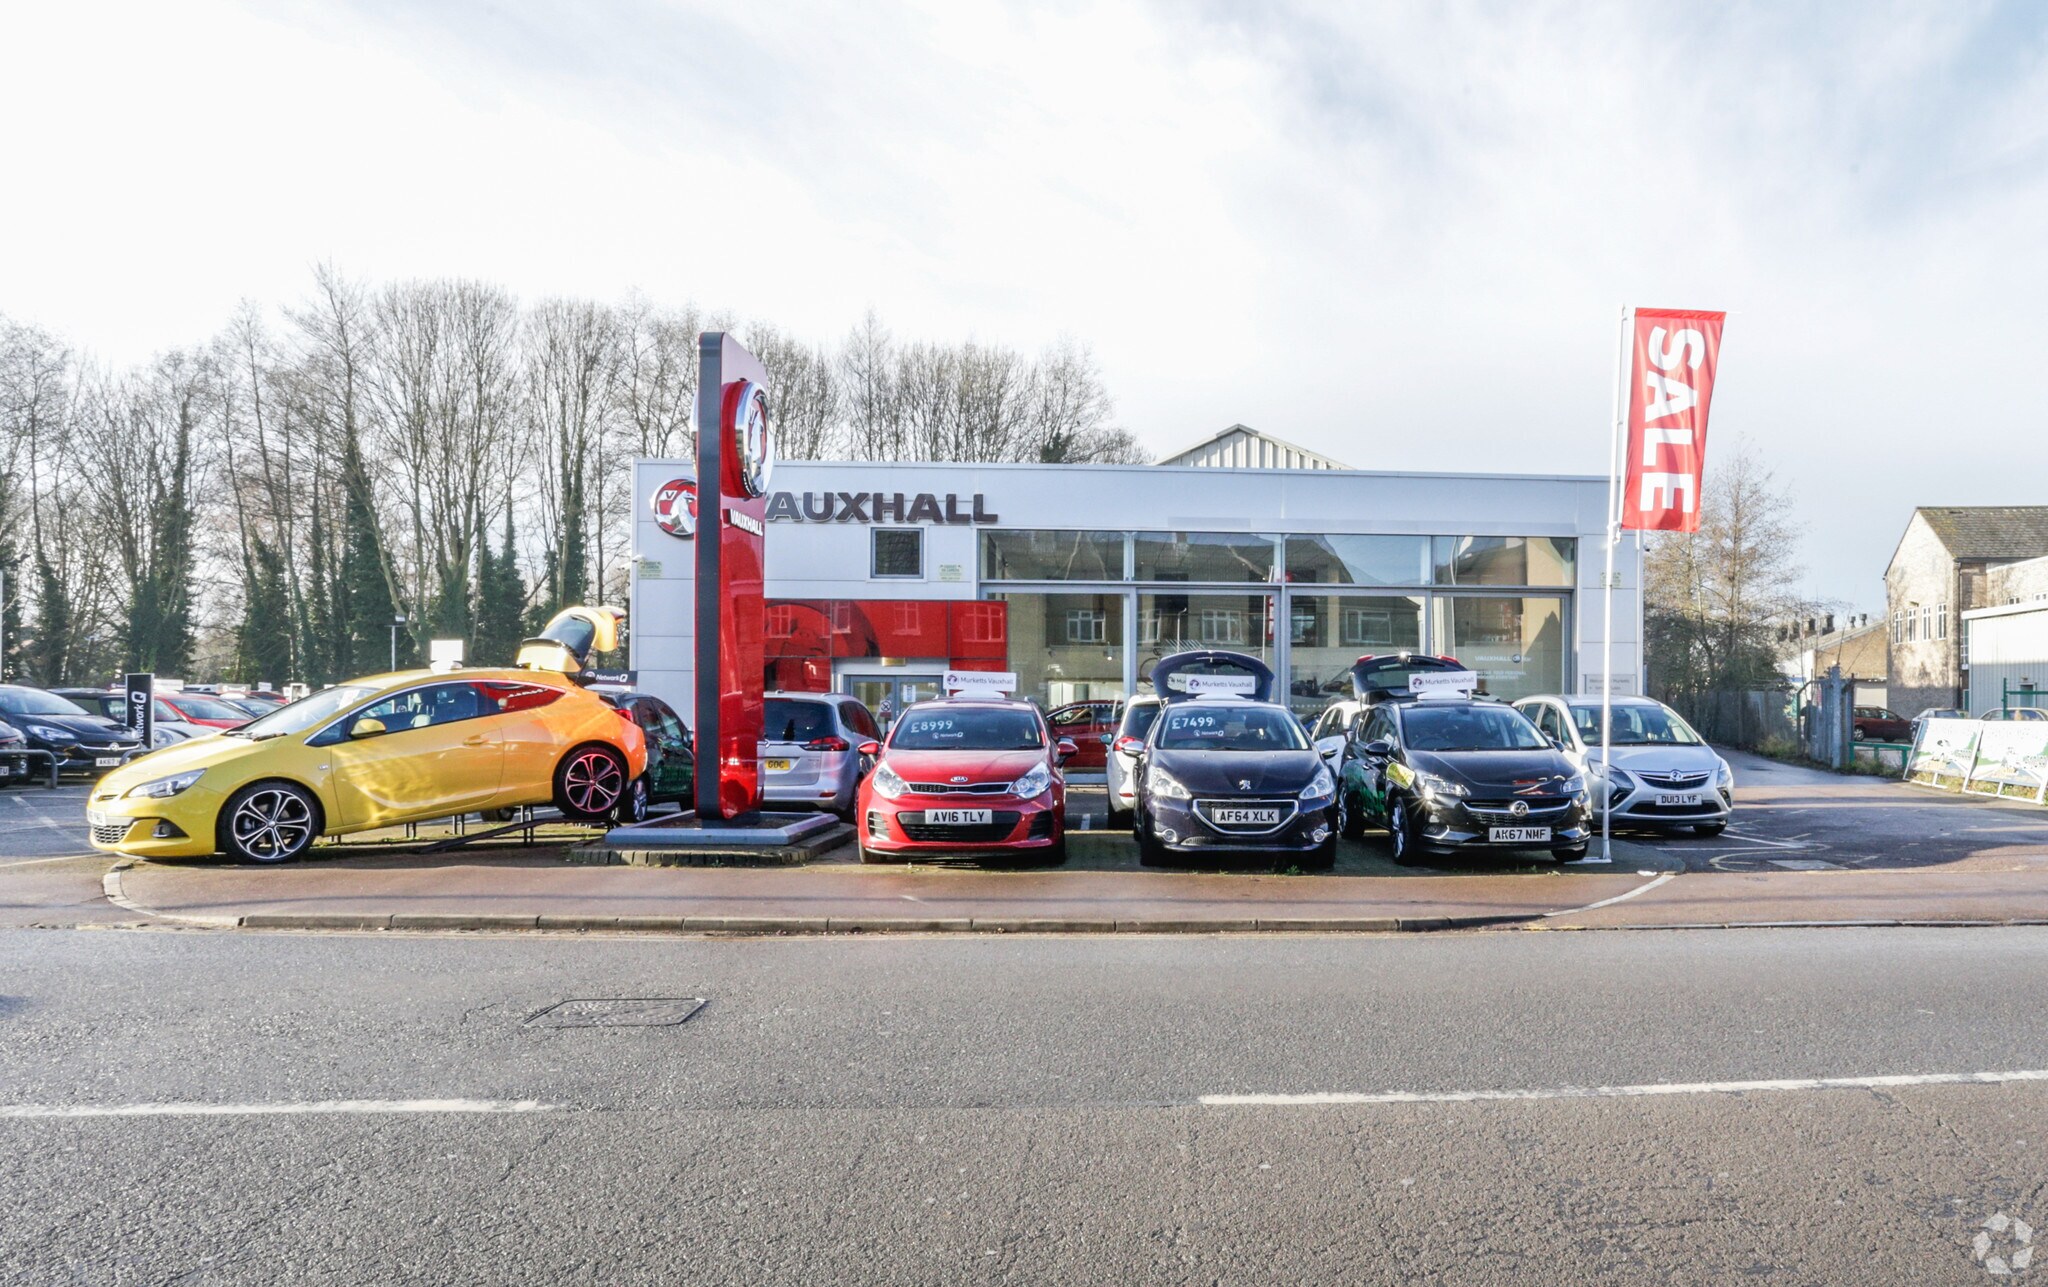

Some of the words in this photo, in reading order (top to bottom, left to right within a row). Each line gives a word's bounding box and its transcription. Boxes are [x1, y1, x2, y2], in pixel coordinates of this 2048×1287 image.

[1640, 326, 1706, 514] SALE
[765, 491, 998, 522] AUXHALL
[730, 508, 763, 537] VAUXHALL
[131, 691, 147, 704] Q
[911, 720, 953, 733] £8999
[1172, 716, 1213, 729] £7499
[1661, 795, 1680, 804] DU13
[1681, 795, 1697, 804] LYF
[933, 811, 959, 822] AV16
[962, 811, 985, 822] TLY
[1220, 811, 1249, 821] AF64
[1252, 811, 1275, 822] XLK
[1494, 829, 1523, 840] AK67
[1525, 829, 1547, 839] NMF
